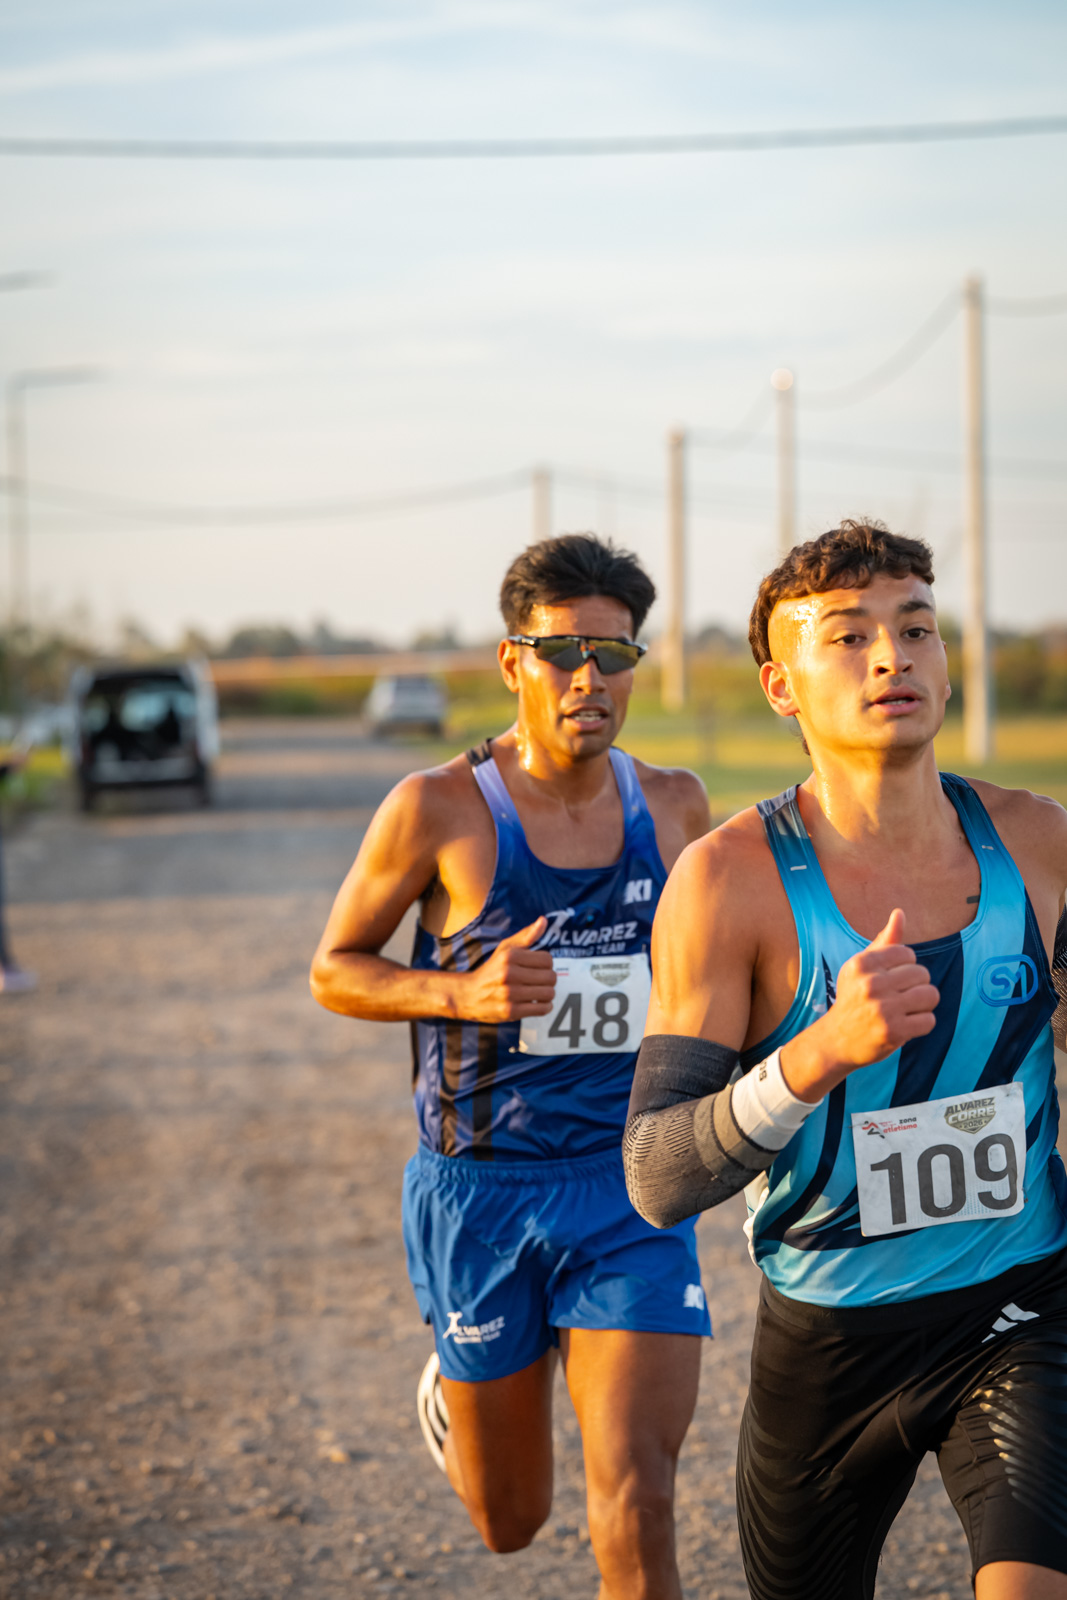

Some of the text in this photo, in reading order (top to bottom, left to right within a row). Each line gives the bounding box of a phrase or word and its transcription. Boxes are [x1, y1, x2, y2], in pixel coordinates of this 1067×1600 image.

[595, 942, 626, 956] TEAM
[548, 991, 629, 1049] 48
[946, 1097, 995, 1116] ALVAREZ
[948, 1107, 995, 1124] CORRE
[882, 1123, 918, 1134] atletismo
[870, 1133, 1018, 1225] 109
